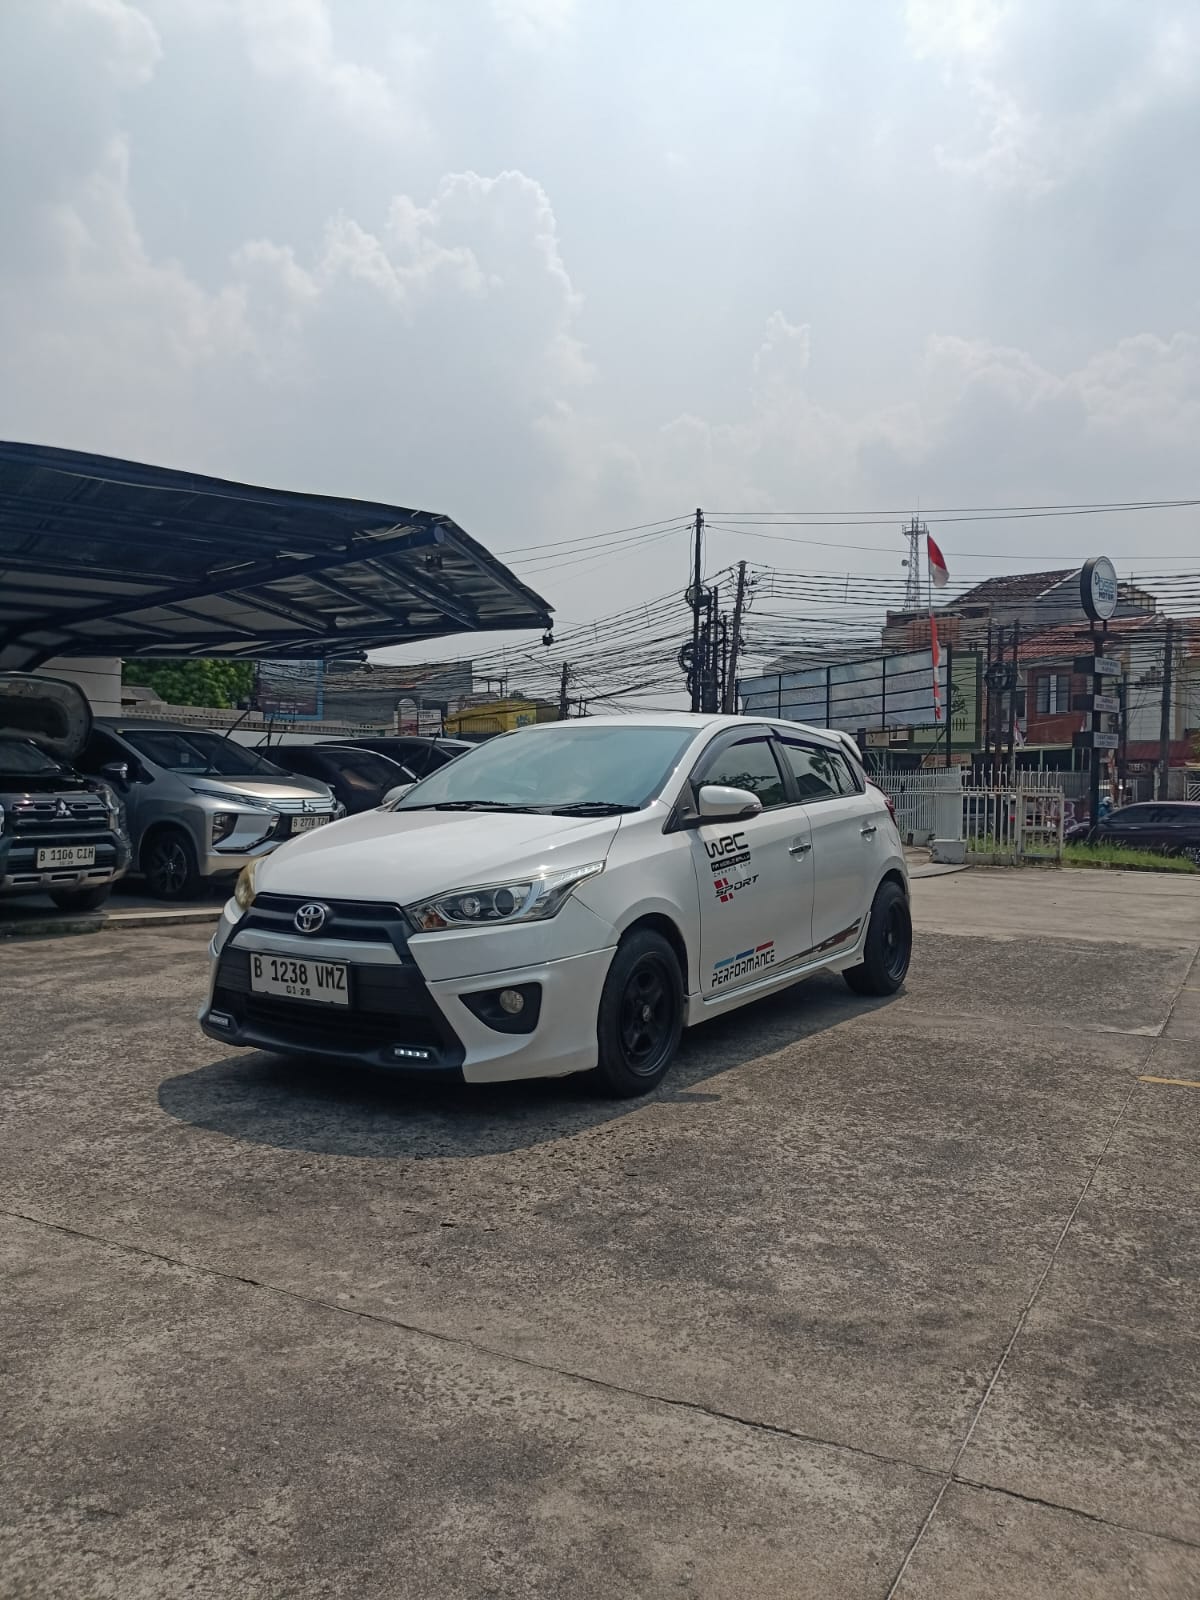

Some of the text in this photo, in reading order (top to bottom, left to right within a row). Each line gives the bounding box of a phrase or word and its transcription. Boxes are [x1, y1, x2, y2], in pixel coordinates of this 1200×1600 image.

[40, 850, 46, 862] B
[50, 849, 73, 861] 1106
[704, 831, 749, 859] WRC
[715, 873, 759, 898] SPORT
[254, 957, 346, 990] B 1238 VMZ
[711, 949, 775, 988] PERFORMANCE
